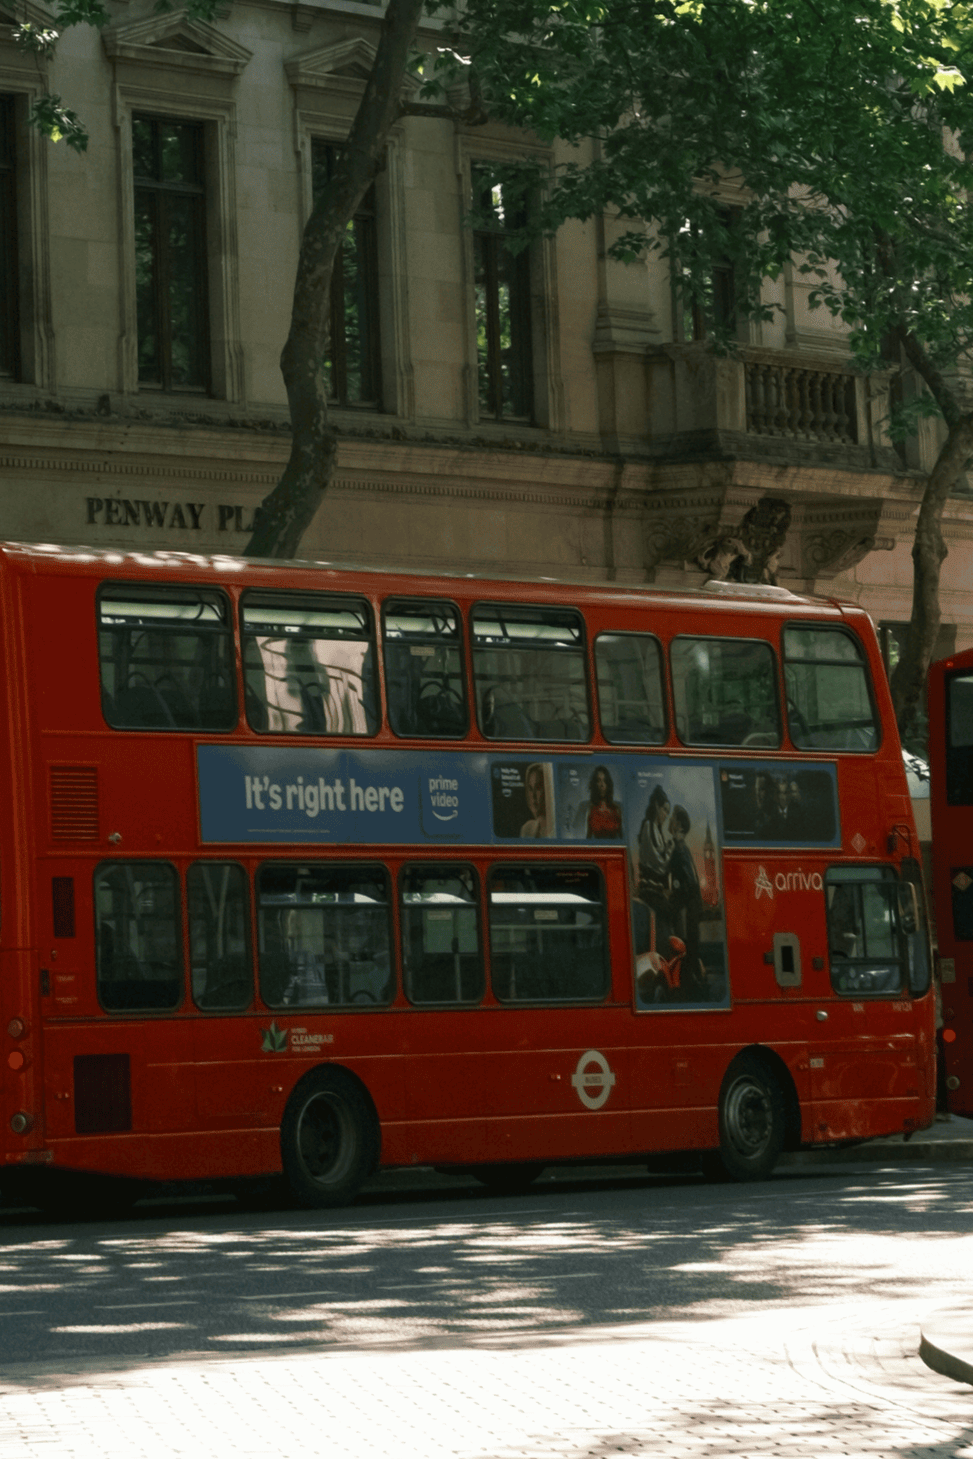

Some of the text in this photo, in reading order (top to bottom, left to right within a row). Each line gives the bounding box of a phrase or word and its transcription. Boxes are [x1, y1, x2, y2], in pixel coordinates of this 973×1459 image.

[86, 497, 205, 530] PENWAY
[428, 775, 459, 793] prime
[244, 775, 405, 818] It's right here
[430, 792, 459, 807] video
[775, 867, 823, 891] arriva
